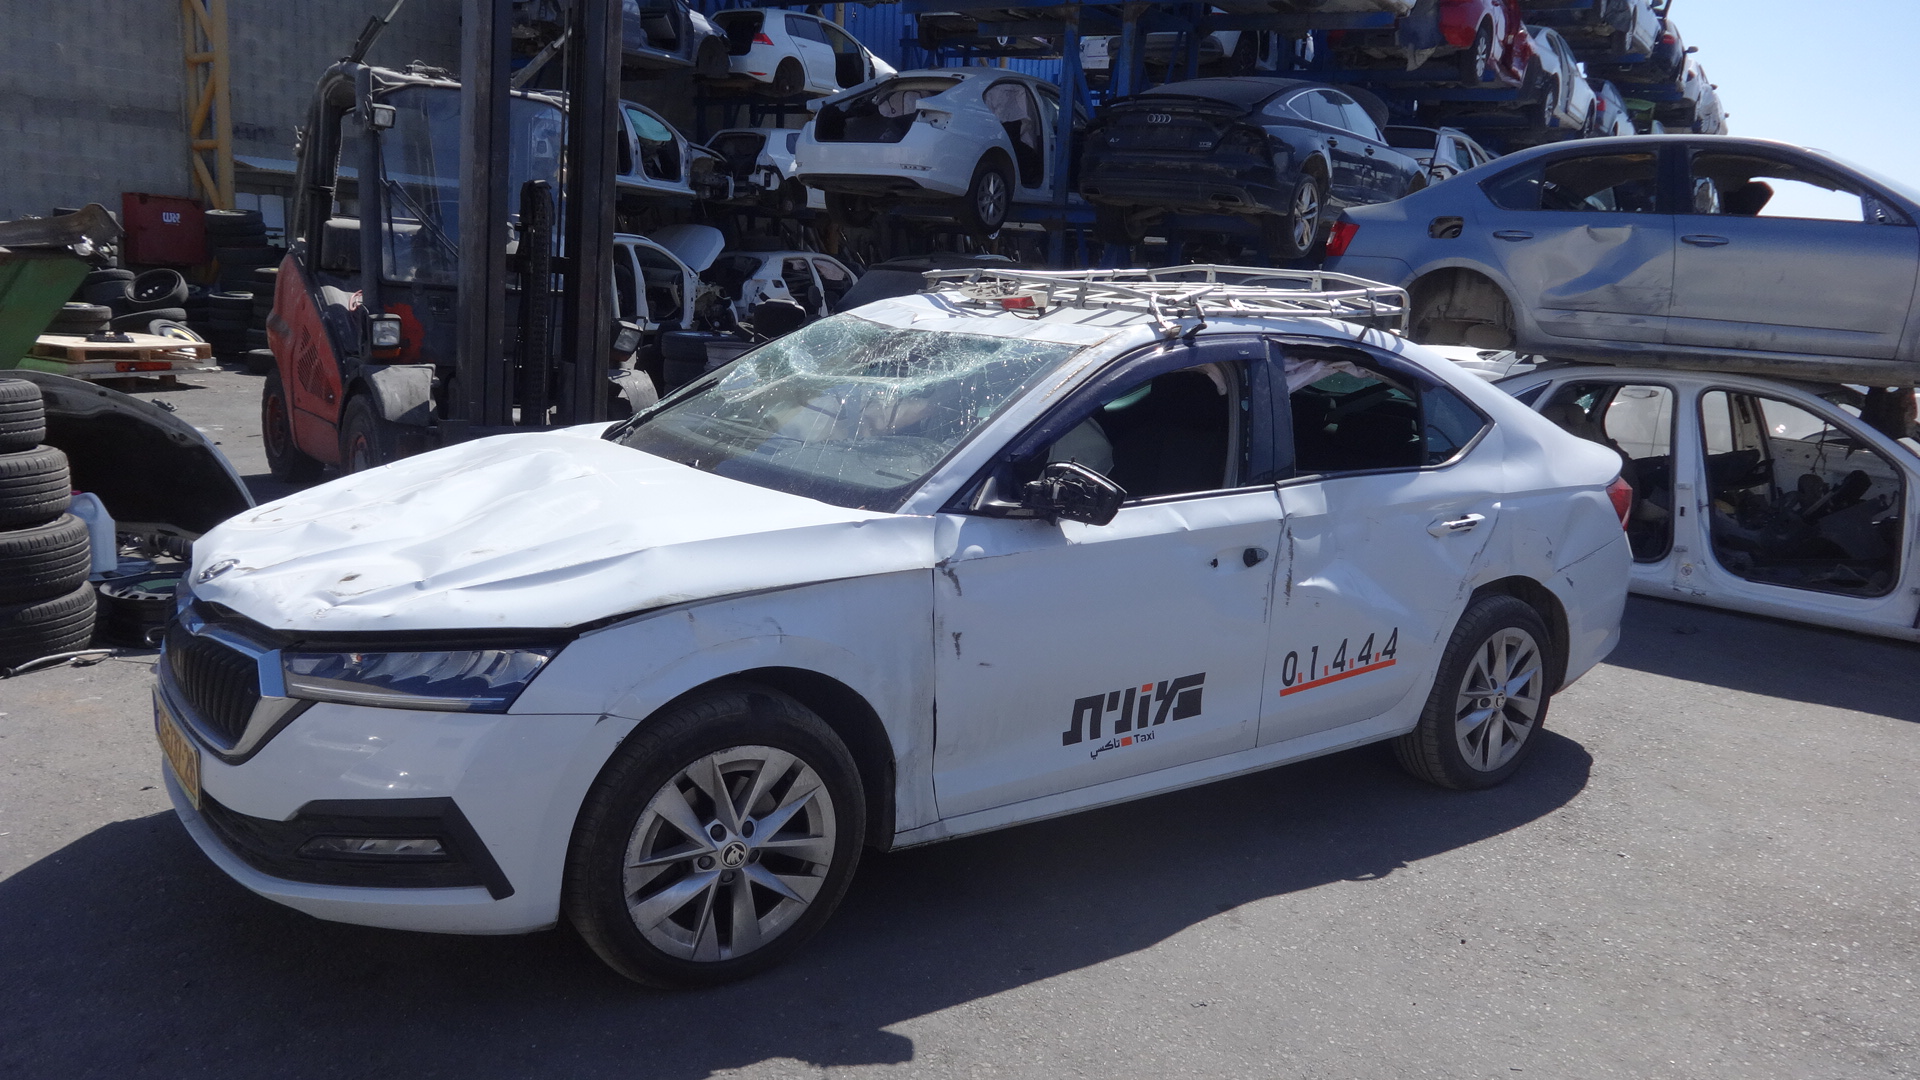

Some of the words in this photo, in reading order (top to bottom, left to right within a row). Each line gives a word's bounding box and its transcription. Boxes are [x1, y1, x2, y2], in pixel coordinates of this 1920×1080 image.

[1062, 672, 1206, 747] מונית
[1133, 730, 1155, 744] Taxi
[1090, 738, 1121, 760] تاكسي
